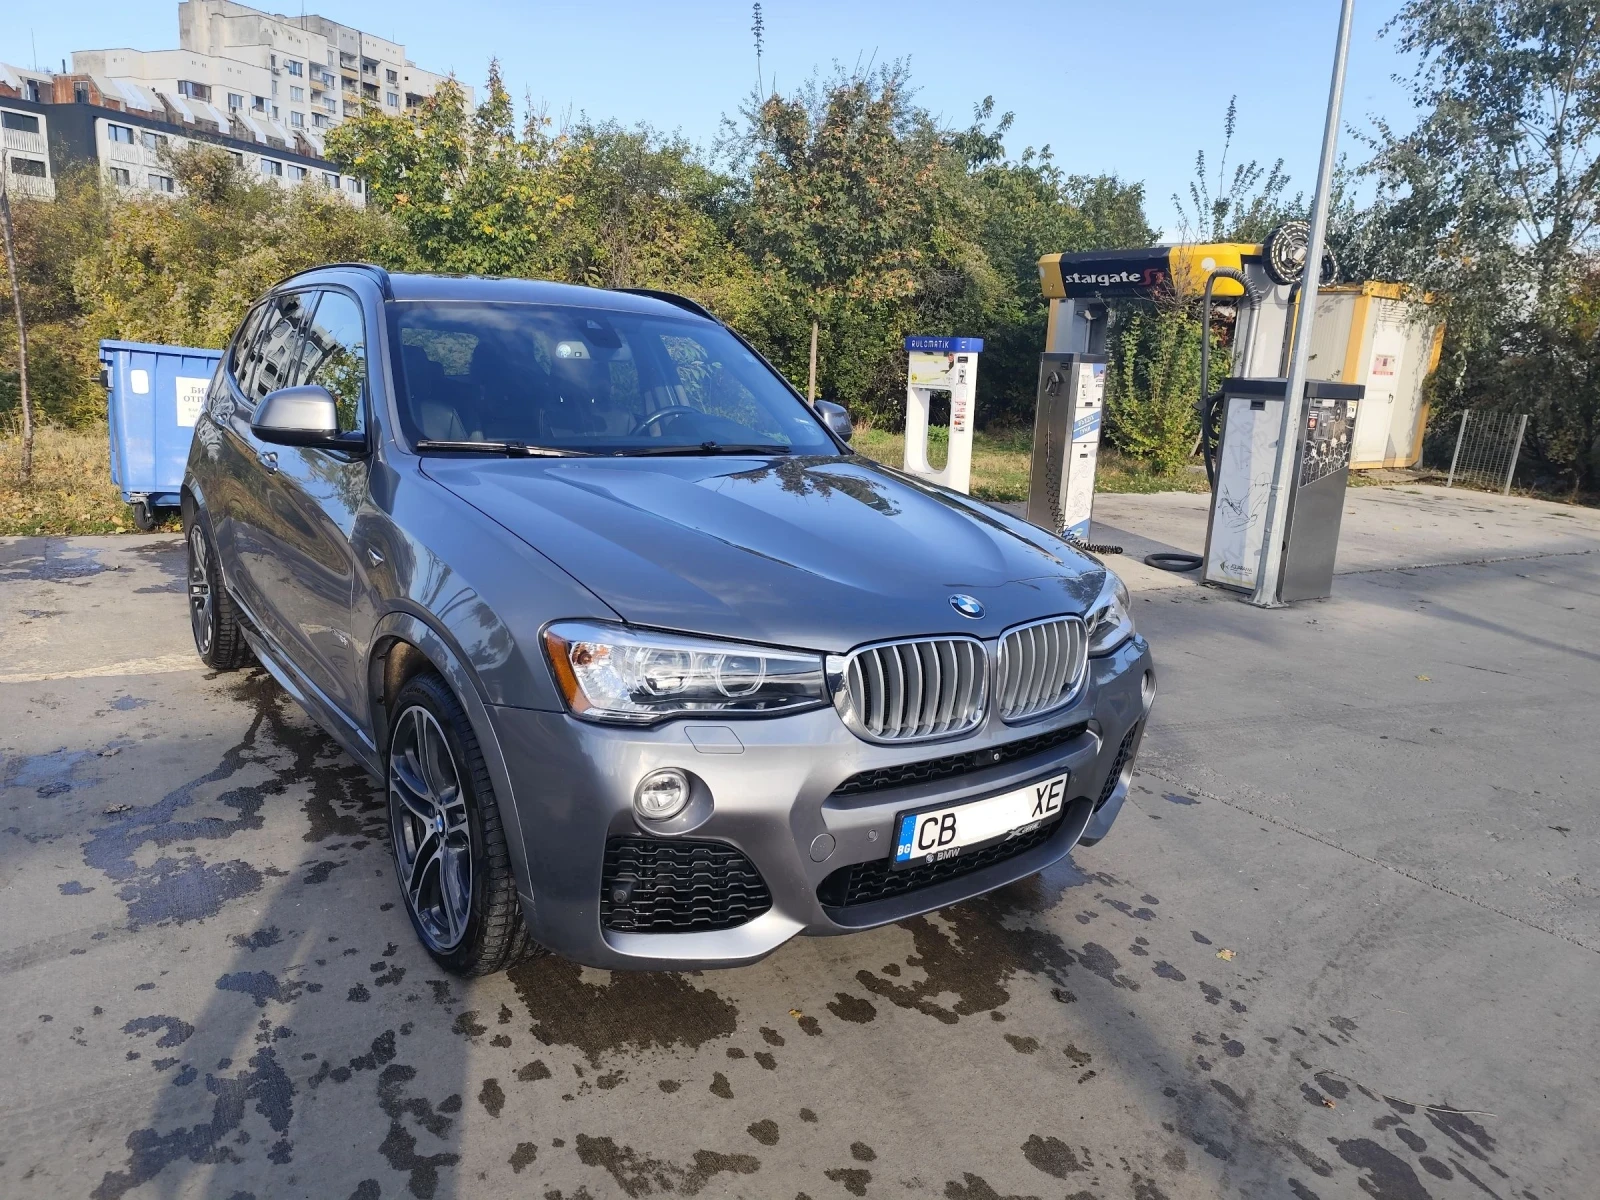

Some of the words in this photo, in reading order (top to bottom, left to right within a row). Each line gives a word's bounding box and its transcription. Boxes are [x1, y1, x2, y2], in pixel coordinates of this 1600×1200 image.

[1065, 271, 1141, 286] stargate
[918, 813, 957, 850] CB
[1031, 779, 1064, 818] XE
[897, 844, 911, 856] BG
[936, 848, 960, 861] BMW
